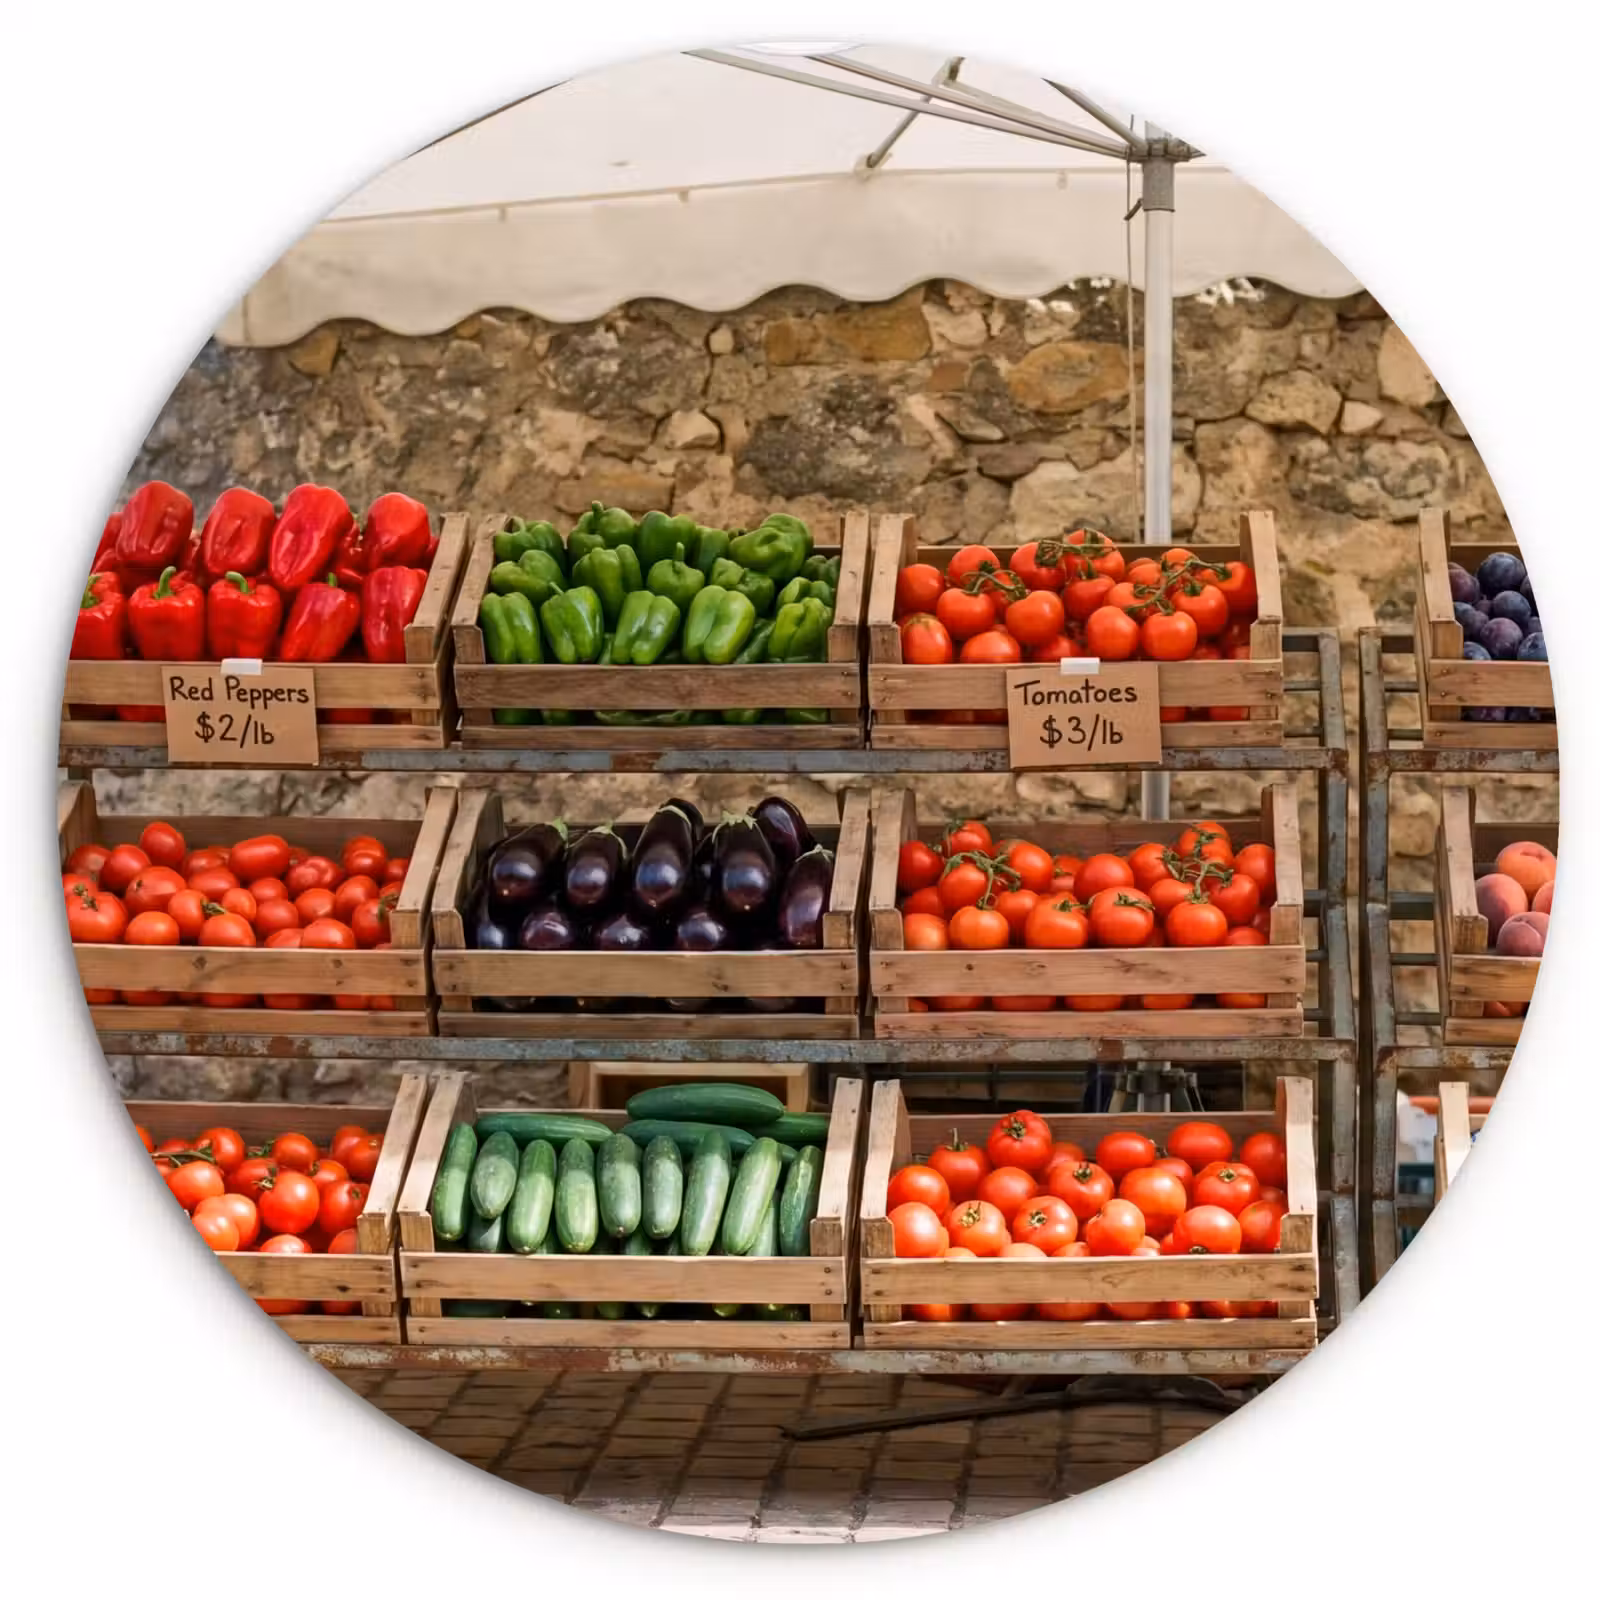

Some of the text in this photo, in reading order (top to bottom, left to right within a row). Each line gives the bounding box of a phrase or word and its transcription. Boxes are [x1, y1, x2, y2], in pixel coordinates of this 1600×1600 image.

[169, 675, 309, 710] Red Peppers
[1014, 678, 1138, 705] Tomatoes
[195, 711, 275, 748] $2/lb
[1039, 713, 1123, 751] $3/lb
